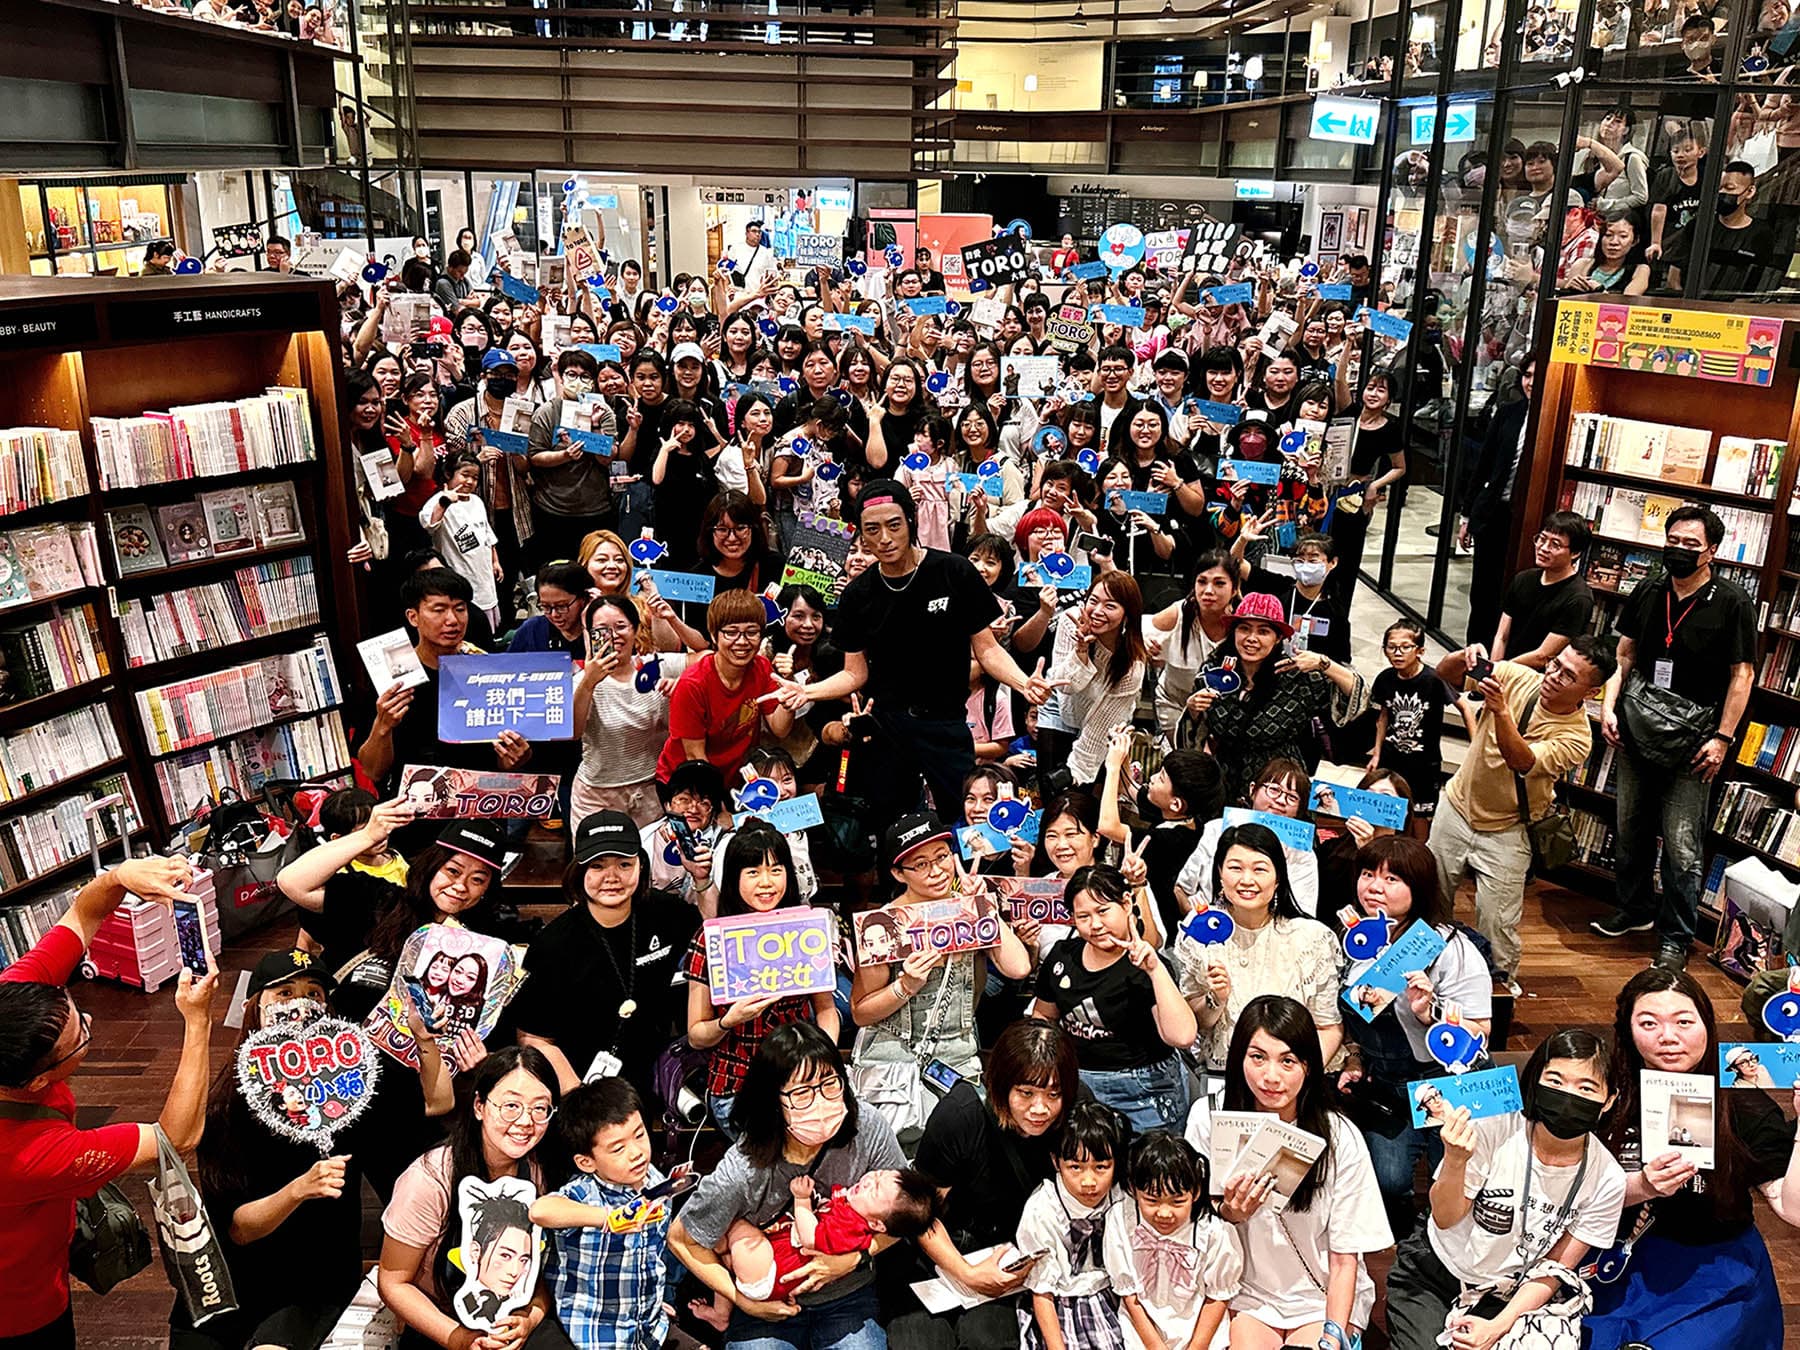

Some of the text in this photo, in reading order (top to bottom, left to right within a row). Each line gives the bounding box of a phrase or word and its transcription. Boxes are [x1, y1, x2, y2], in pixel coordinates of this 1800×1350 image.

[803, 235, 836, 248] TORO
[1196, 223, 1236, 241] TORO
[966, 251, 1025, 280] TORO
[173, 308, 262, 323] 手工藝 HANDICRAFTS
[22, 321, 57, 334] BEAUTY
[1049, 321, 1089, 340] TORO
[485, 685, 565, 707] 我們一起
[465, 705, 565, 728] 譜出下一曲
[454, 792, 552, 816] TORO
[1006, 896, 1071, 921] TOR
[724, 927, 828, 964] Toro
[905, 916, 998, 952] TORO
[249, 1032, 363, 1084] TORO
[194, 1253, 221, 1307] Roots
